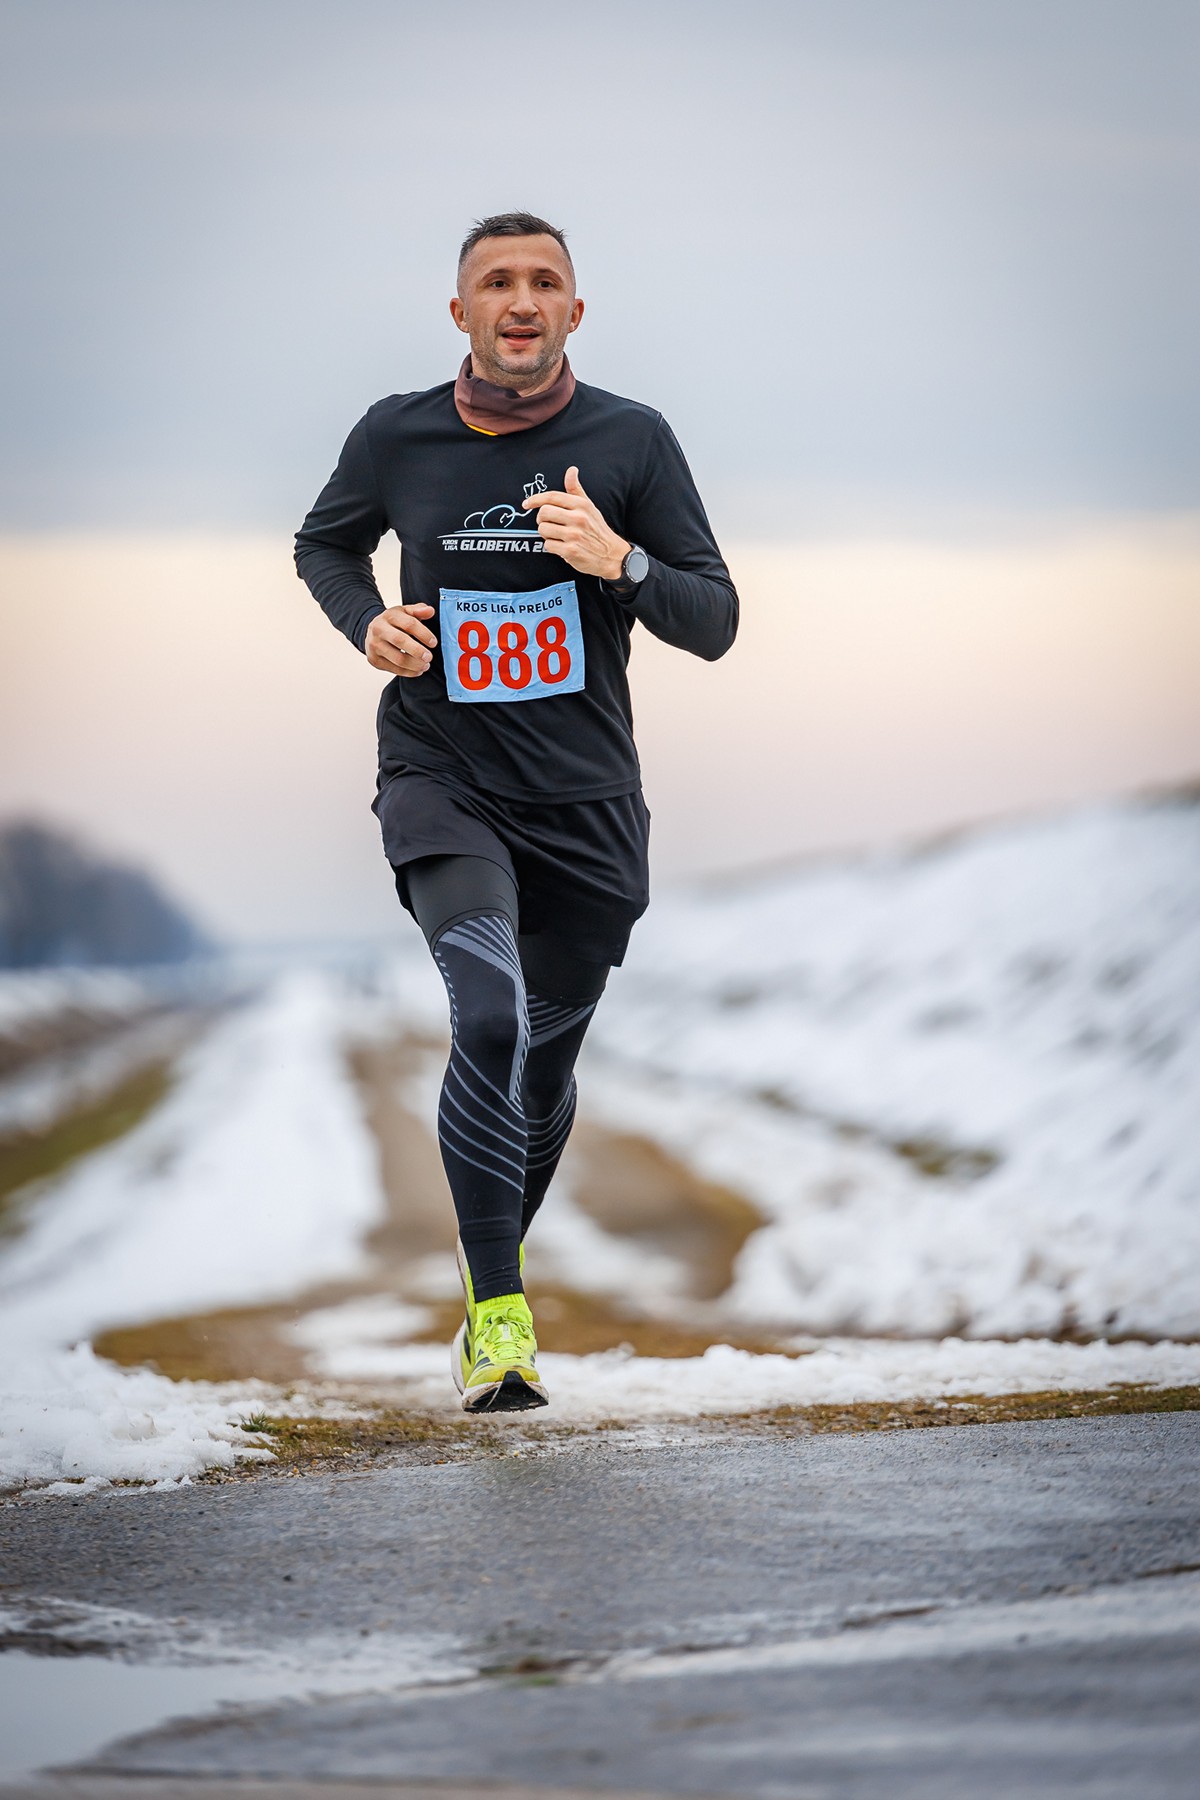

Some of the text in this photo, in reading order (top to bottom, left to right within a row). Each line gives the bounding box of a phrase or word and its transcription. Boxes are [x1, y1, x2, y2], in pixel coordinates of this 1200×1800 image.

[460, 539, 530, 552] GLOBETKA
[456, 596, 563, 614] KROS LIGA PRELOG
[457, 616, 571, 691] 888
